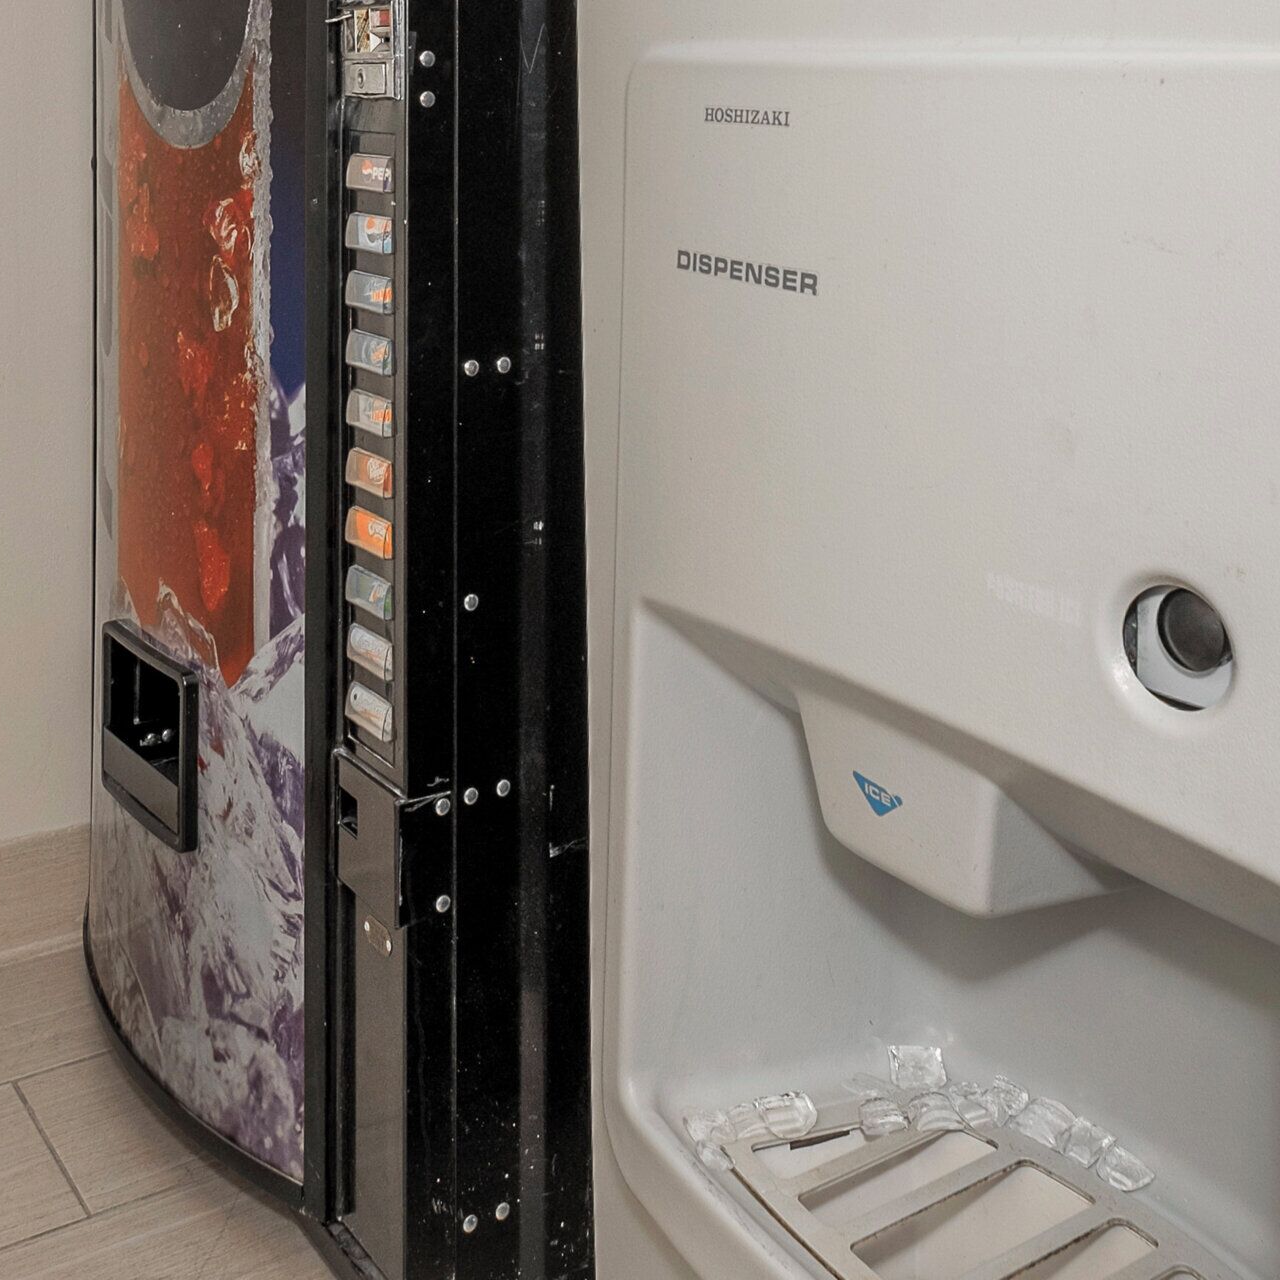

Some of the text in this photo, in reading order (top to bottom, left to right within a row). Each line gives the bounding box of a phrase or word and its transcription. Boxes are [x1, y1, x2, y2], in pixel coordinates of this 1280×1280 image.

[704, 107, 790, 127] HOSHIZAKI
[676, 249, 818, 296] DISPENSER
[865, 782, 891, 807] ICE
